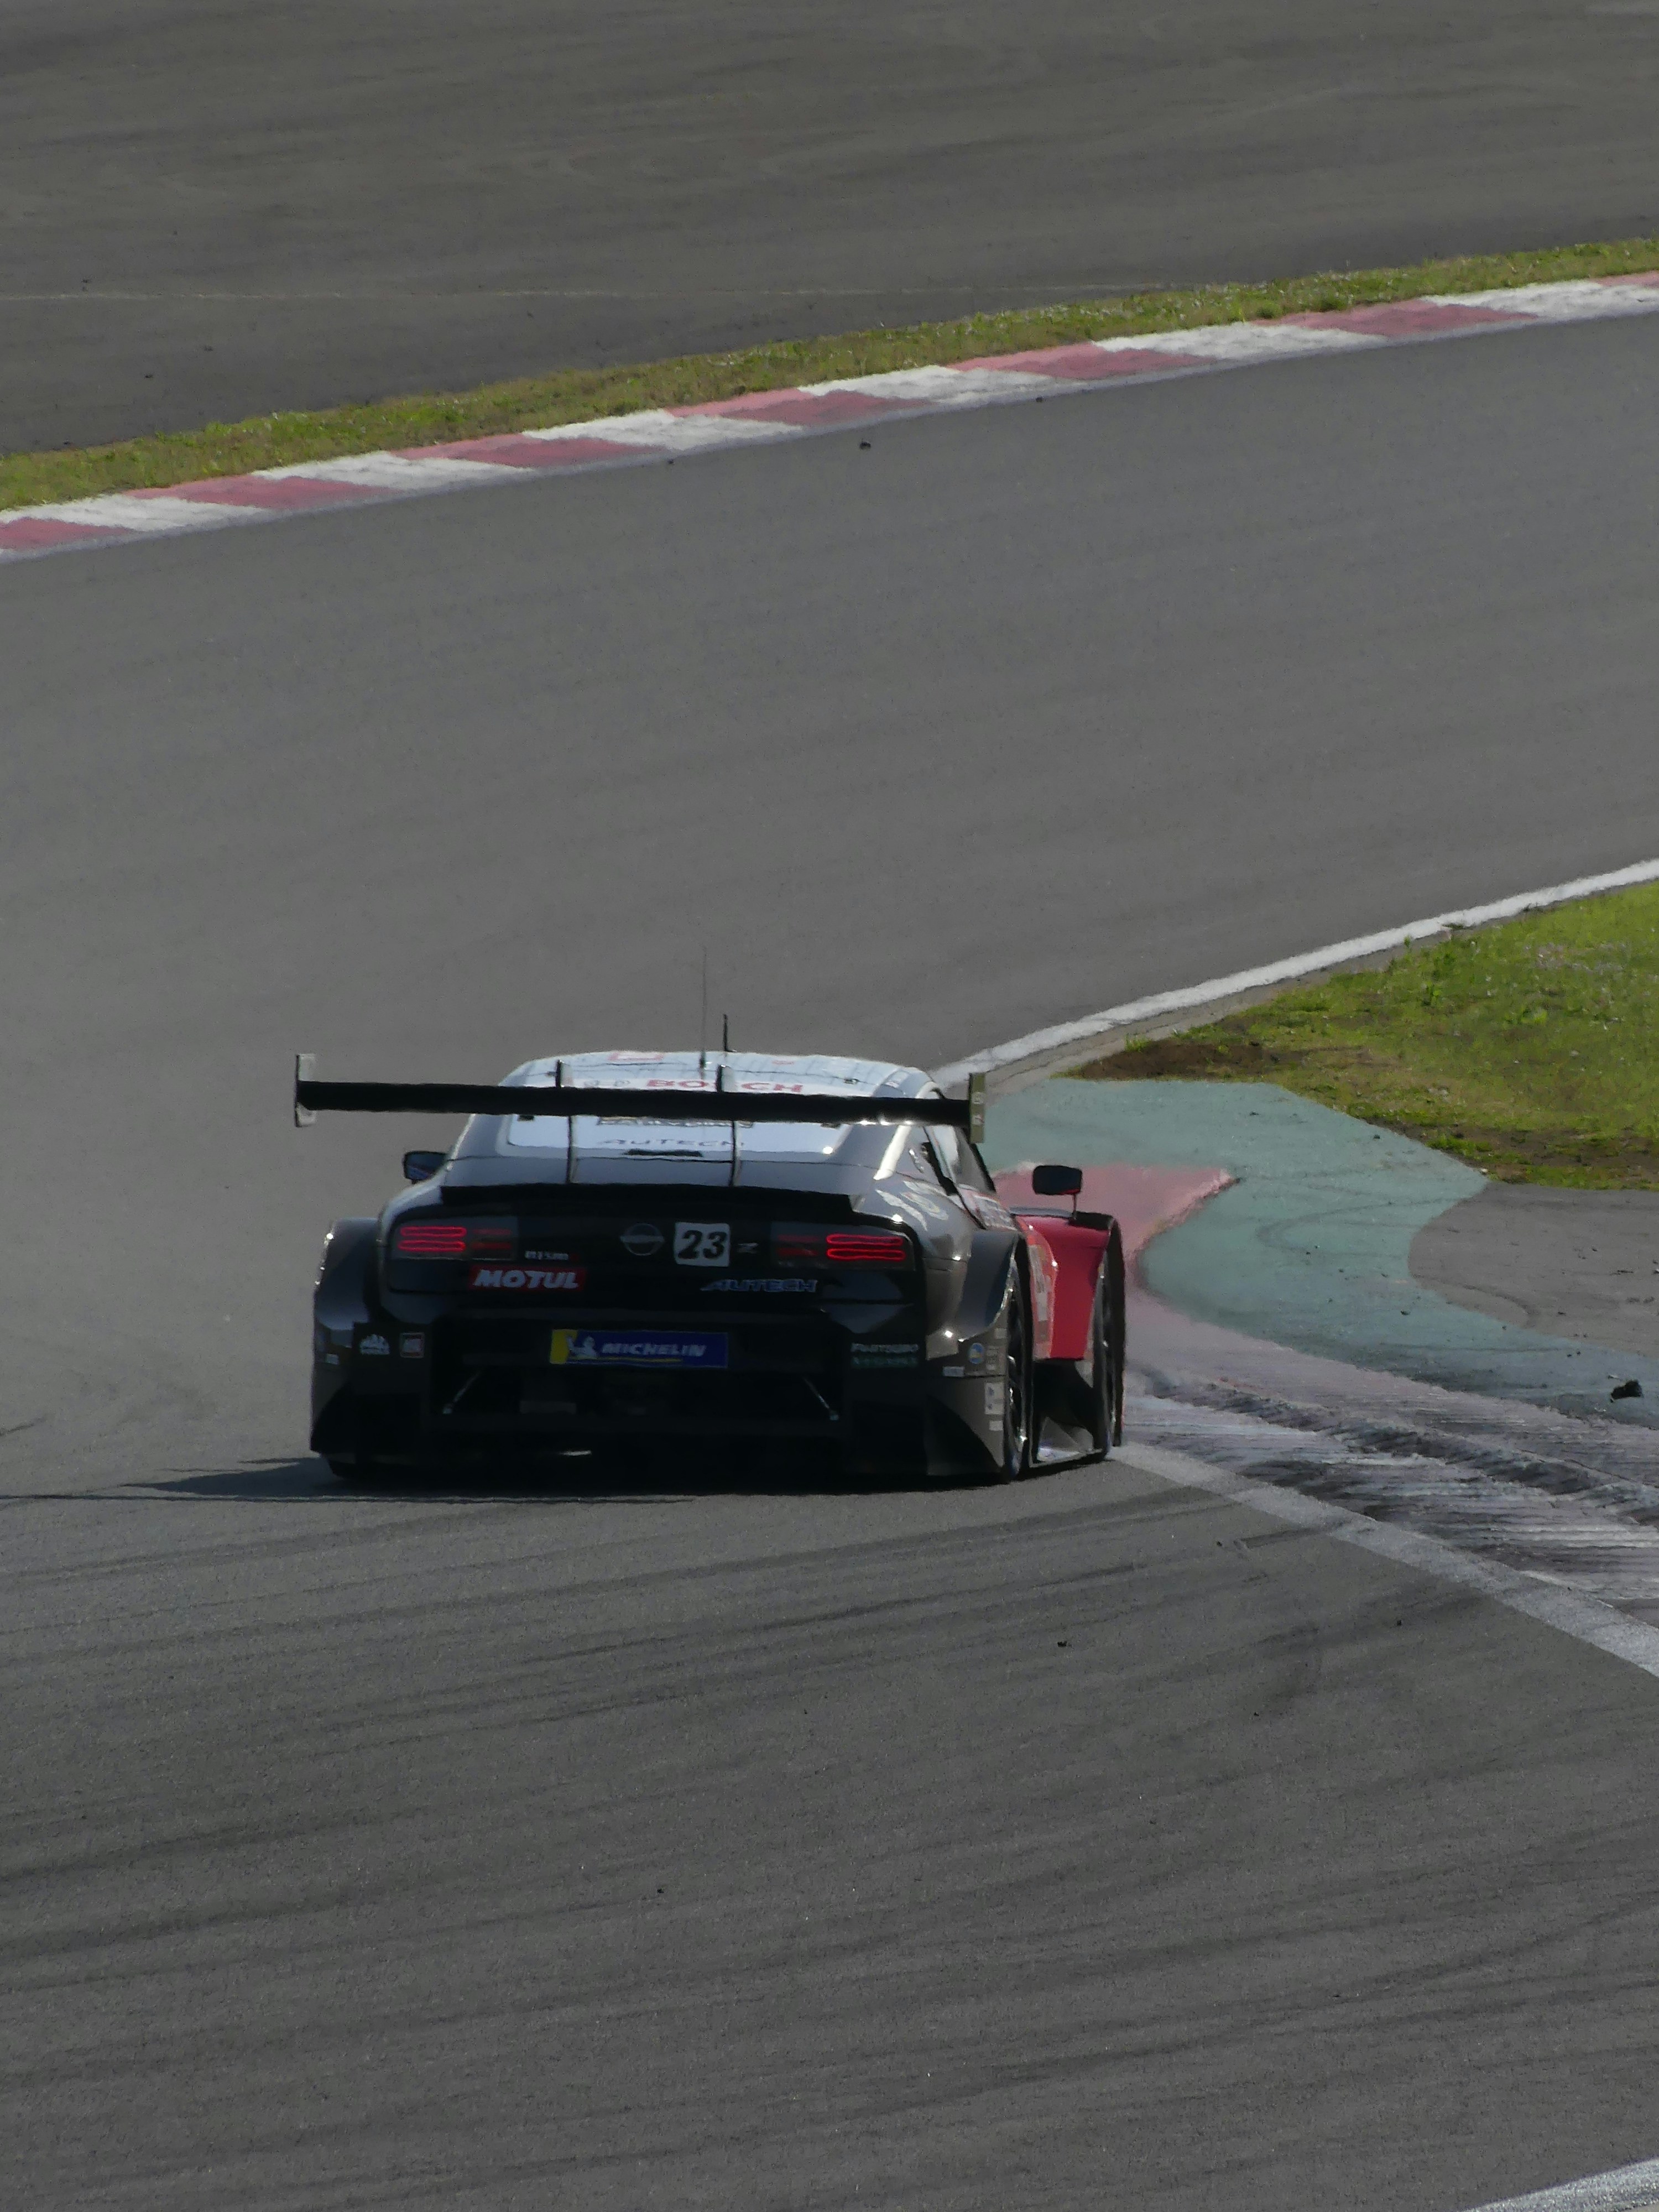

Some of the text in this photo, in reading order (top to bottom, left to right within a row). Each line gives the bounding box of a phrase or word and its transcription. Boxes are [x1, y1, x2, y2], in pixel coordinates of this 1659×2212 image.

[646, 1078, 804, 1093] BOCH
[677, 1228, 726, 1260] 23
[473, 1269, 579, 1288] MOTUL
[700, 1278, 818, 1292] AUTECH
[602, 1343, 707, 1357] MICHELIN
